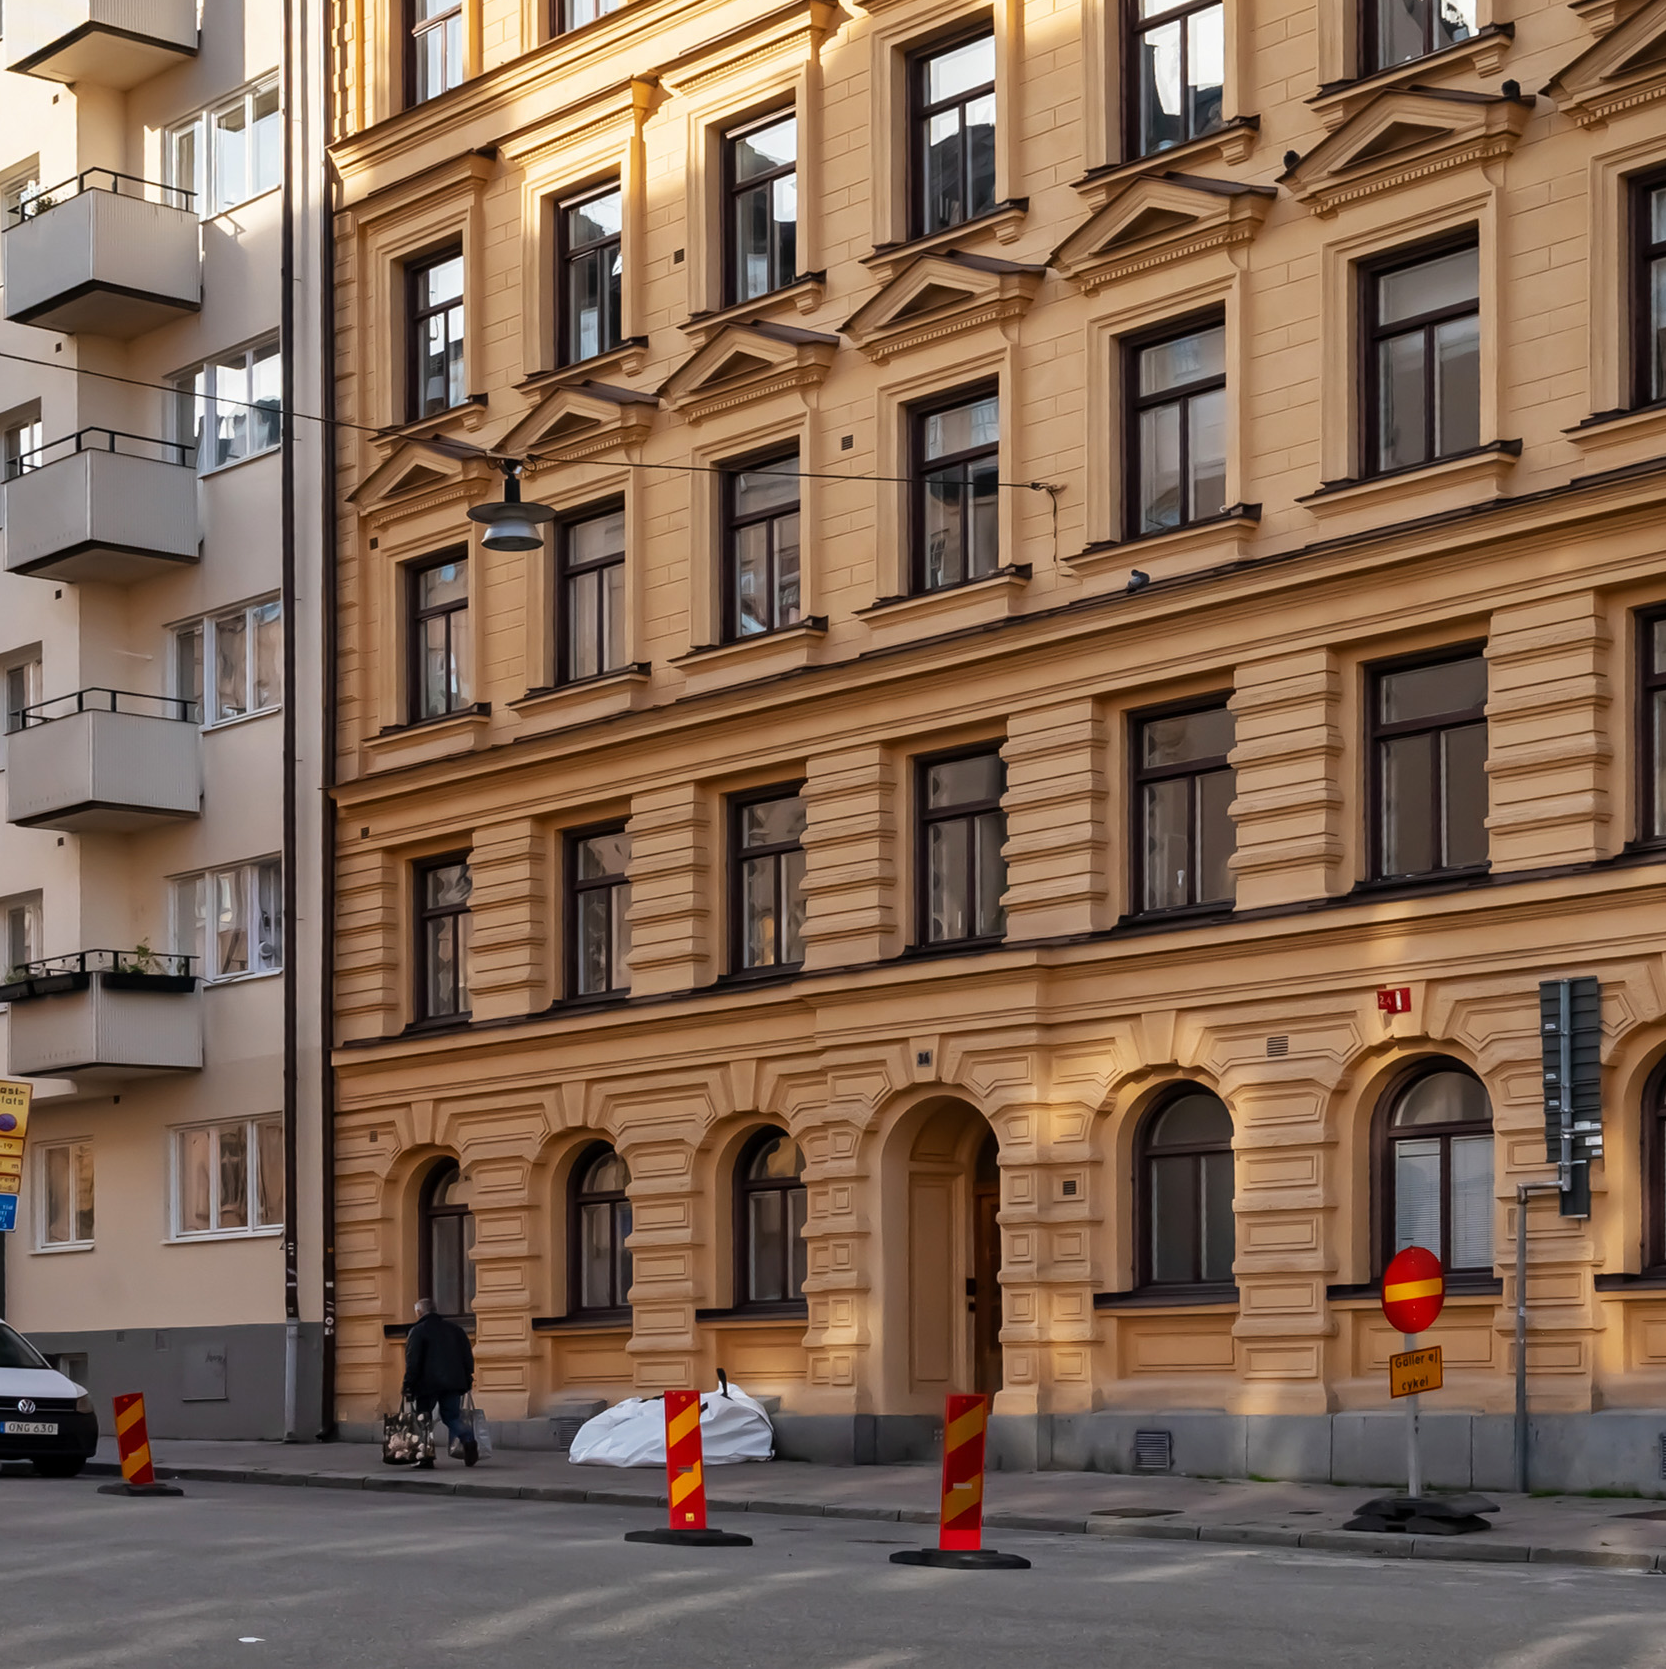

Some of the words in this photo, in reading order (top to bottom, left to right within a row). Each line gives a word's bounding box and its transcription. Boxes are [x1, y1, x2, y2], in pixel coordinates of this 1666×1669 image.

[1395, 1354, 1425, 1368] Gäller
[1428, 1349, 1438, 1363] ej
[1401, 1375, 1429, 1391] cykel
[33, 1424, 54, 1433] 630
